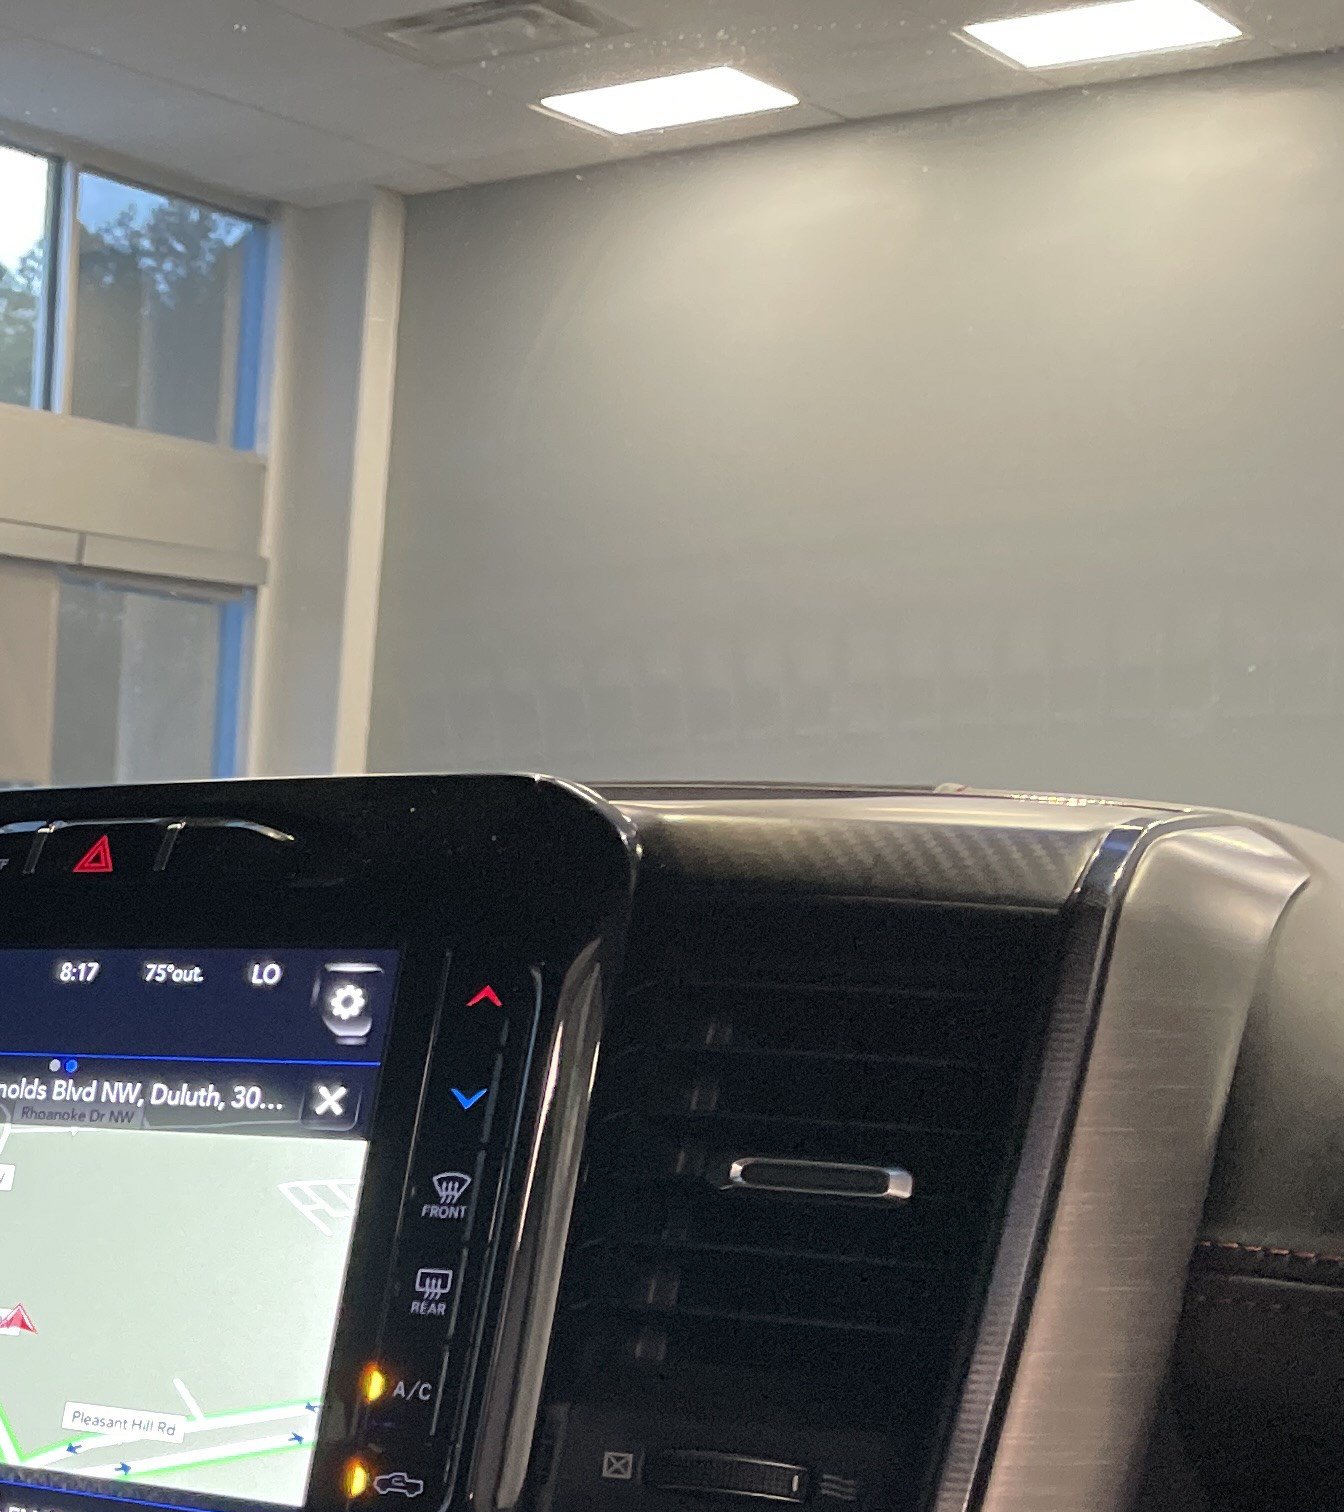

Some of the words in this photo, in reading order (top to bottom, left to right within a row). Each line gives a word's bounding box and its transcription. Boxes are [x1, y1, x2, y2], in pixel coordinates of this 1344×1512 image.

[59, 962, 99, 982] 8:17
[251, 963, 282, 984] LO
[52, 1079, 98, 1101] Blvd
[101, 1082, 144, 1108] NW,
[150, 1083, 225, 1111] Duluth,
[230, 1085, 283, 1110] 30...
[89, 1109, 107, 1123] Dr
[109, 1110, 135, 1124] NW
[422, 1204, 467, 1220] FRONT
[410, 1300, 447, 1316] REAR
[392, 1380, 432, 1401] A/C
[71, 1410, 127, 1434] Pleasant
[132, 1416, 153, 1434] Hill
[159, 1419, 177, 1437] Rd
